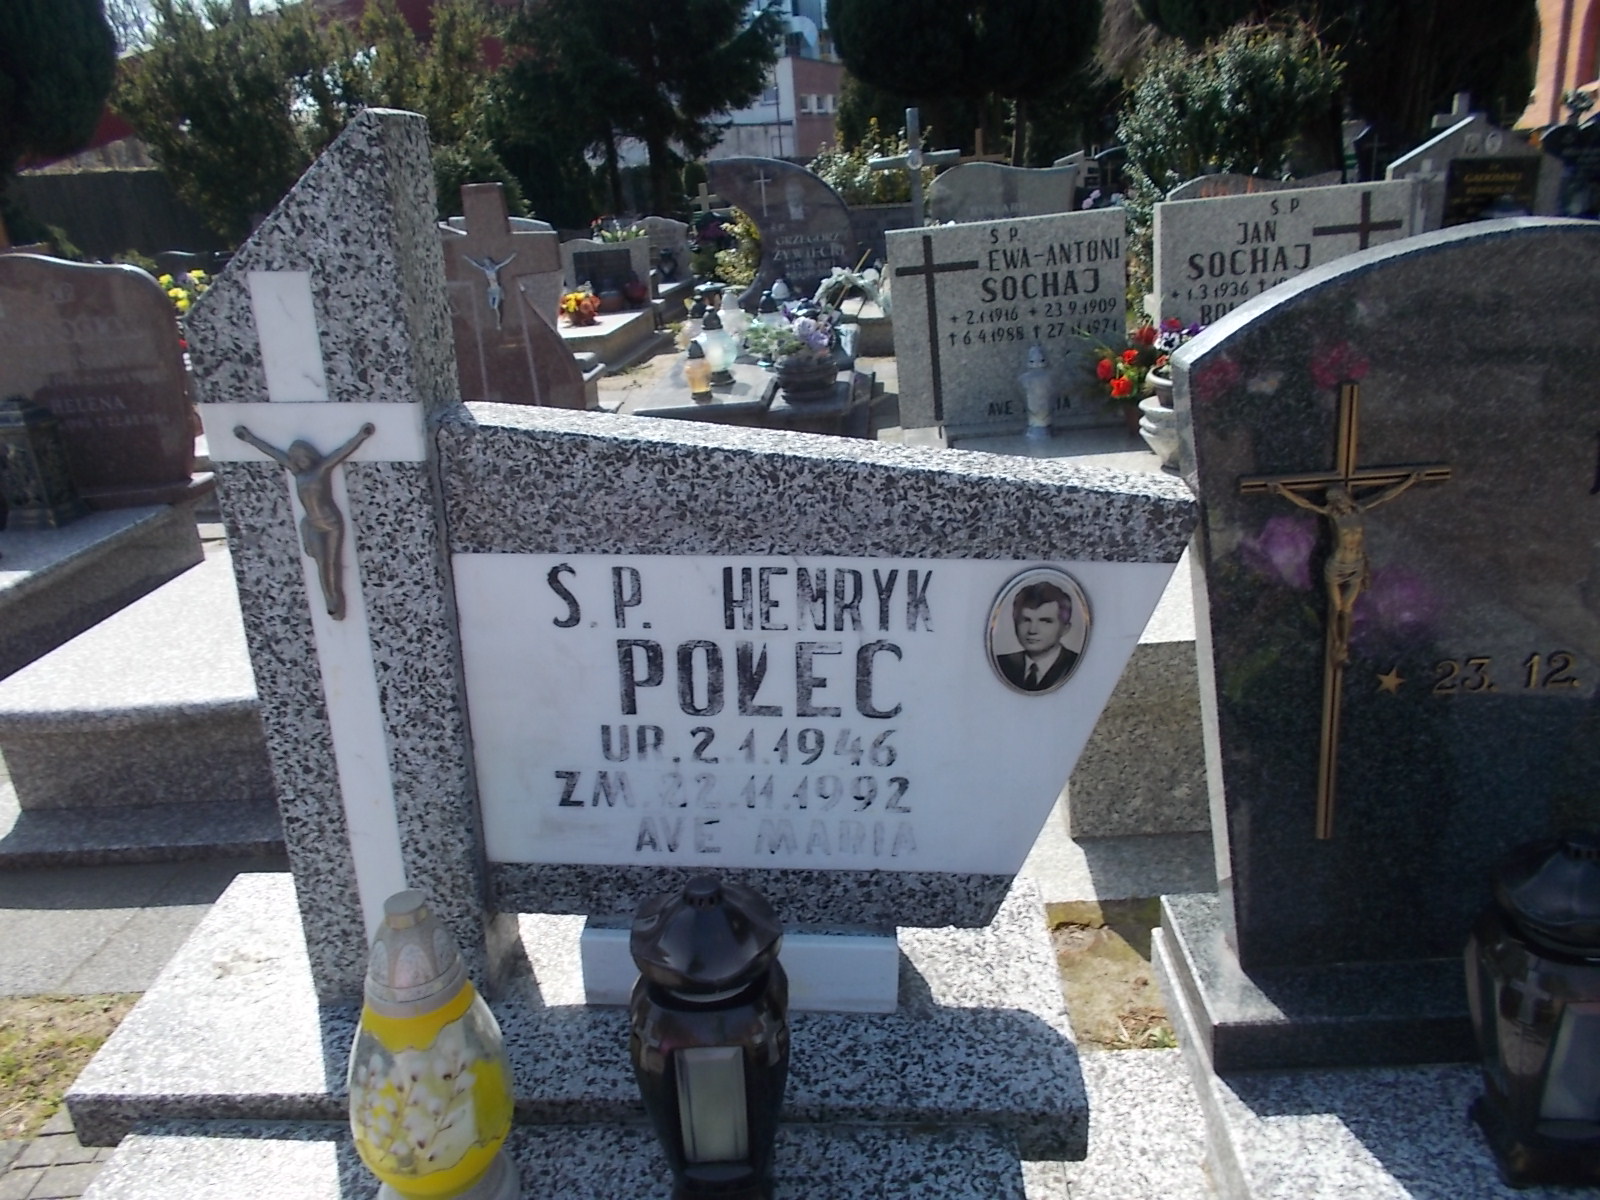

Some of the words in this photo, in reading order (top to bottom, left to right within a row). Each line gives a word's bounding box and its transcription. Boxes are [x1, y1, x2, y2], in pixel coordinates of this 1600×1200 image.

[1236, 220, 1277, 245] JAN
[1187, 243, 1311, 280] SOCHAJ
[981, 268, 1100, 303] SOCHAJ
[722, 565, 935, 633] HENRYK
[635, 816, 723, 854] AVE
[754, 818, 918, 857] MARIA
